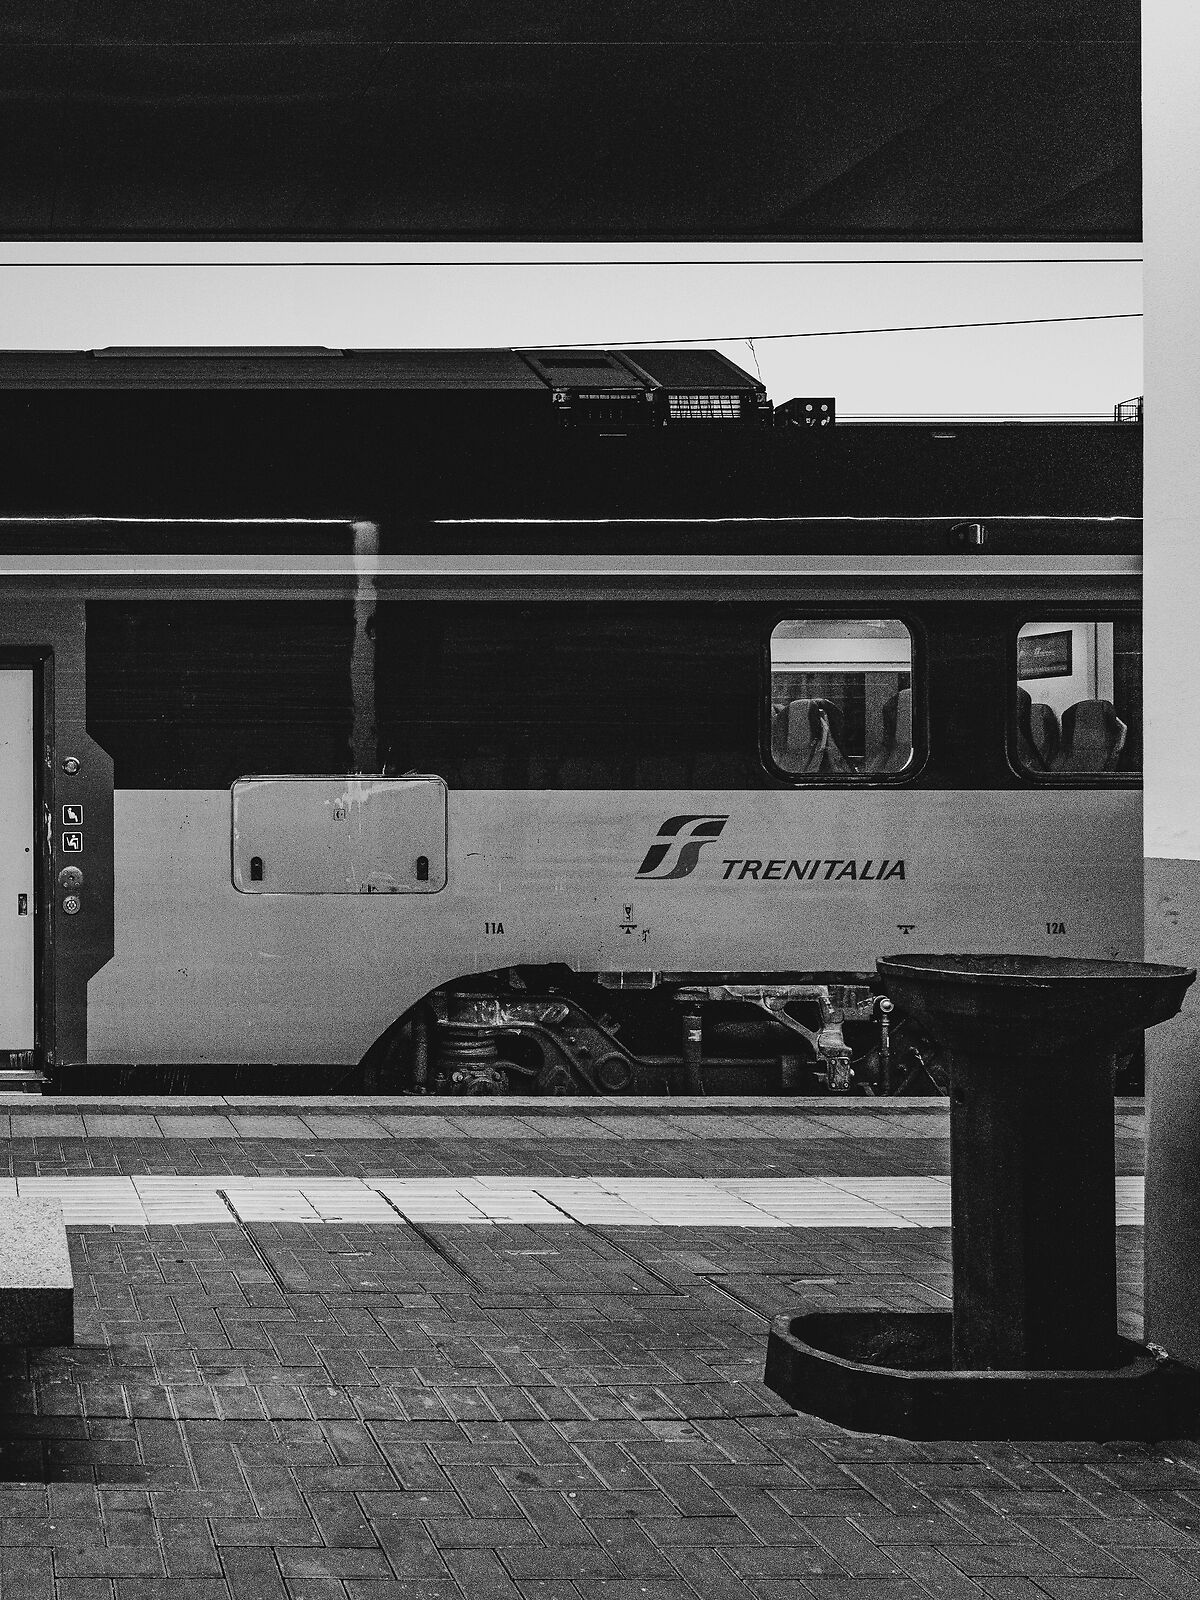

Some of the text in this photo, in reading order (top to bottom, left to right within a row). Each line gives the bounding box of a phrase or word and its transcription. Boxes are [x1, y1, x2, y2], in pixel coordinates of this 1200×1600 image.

[722, 859, 906, 880] TRENITALIA
[484, 922, 505, 935] 11A
[1046, 922, 1066, 935] 12A
